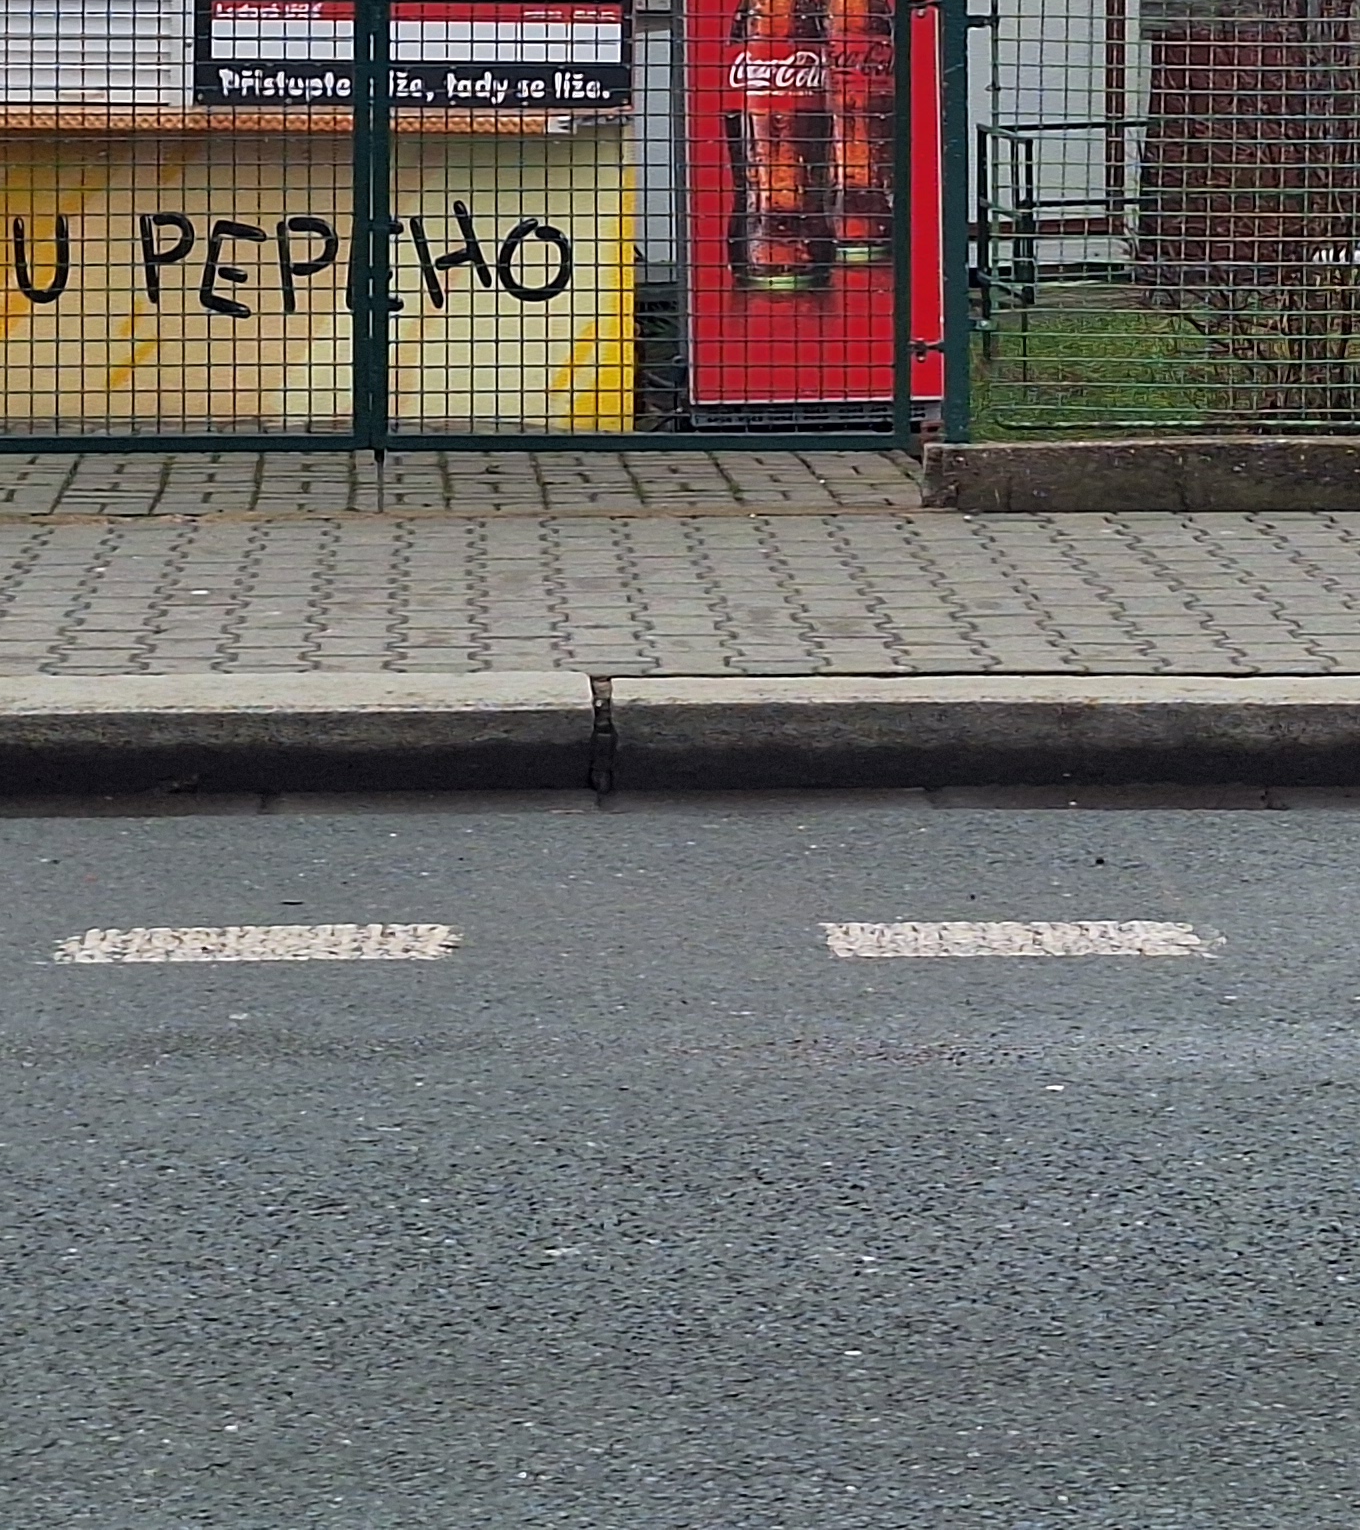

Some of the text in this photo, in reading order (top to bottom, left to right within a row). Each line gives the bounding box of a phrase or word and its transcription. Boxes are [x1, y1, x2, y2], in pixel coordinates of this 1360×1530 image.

[218, 69, 351, 102] Přistupte
[446, 71, 508, 104] tady
[517, 79, 545, 98] se
[13, 214, 69, 304] U
